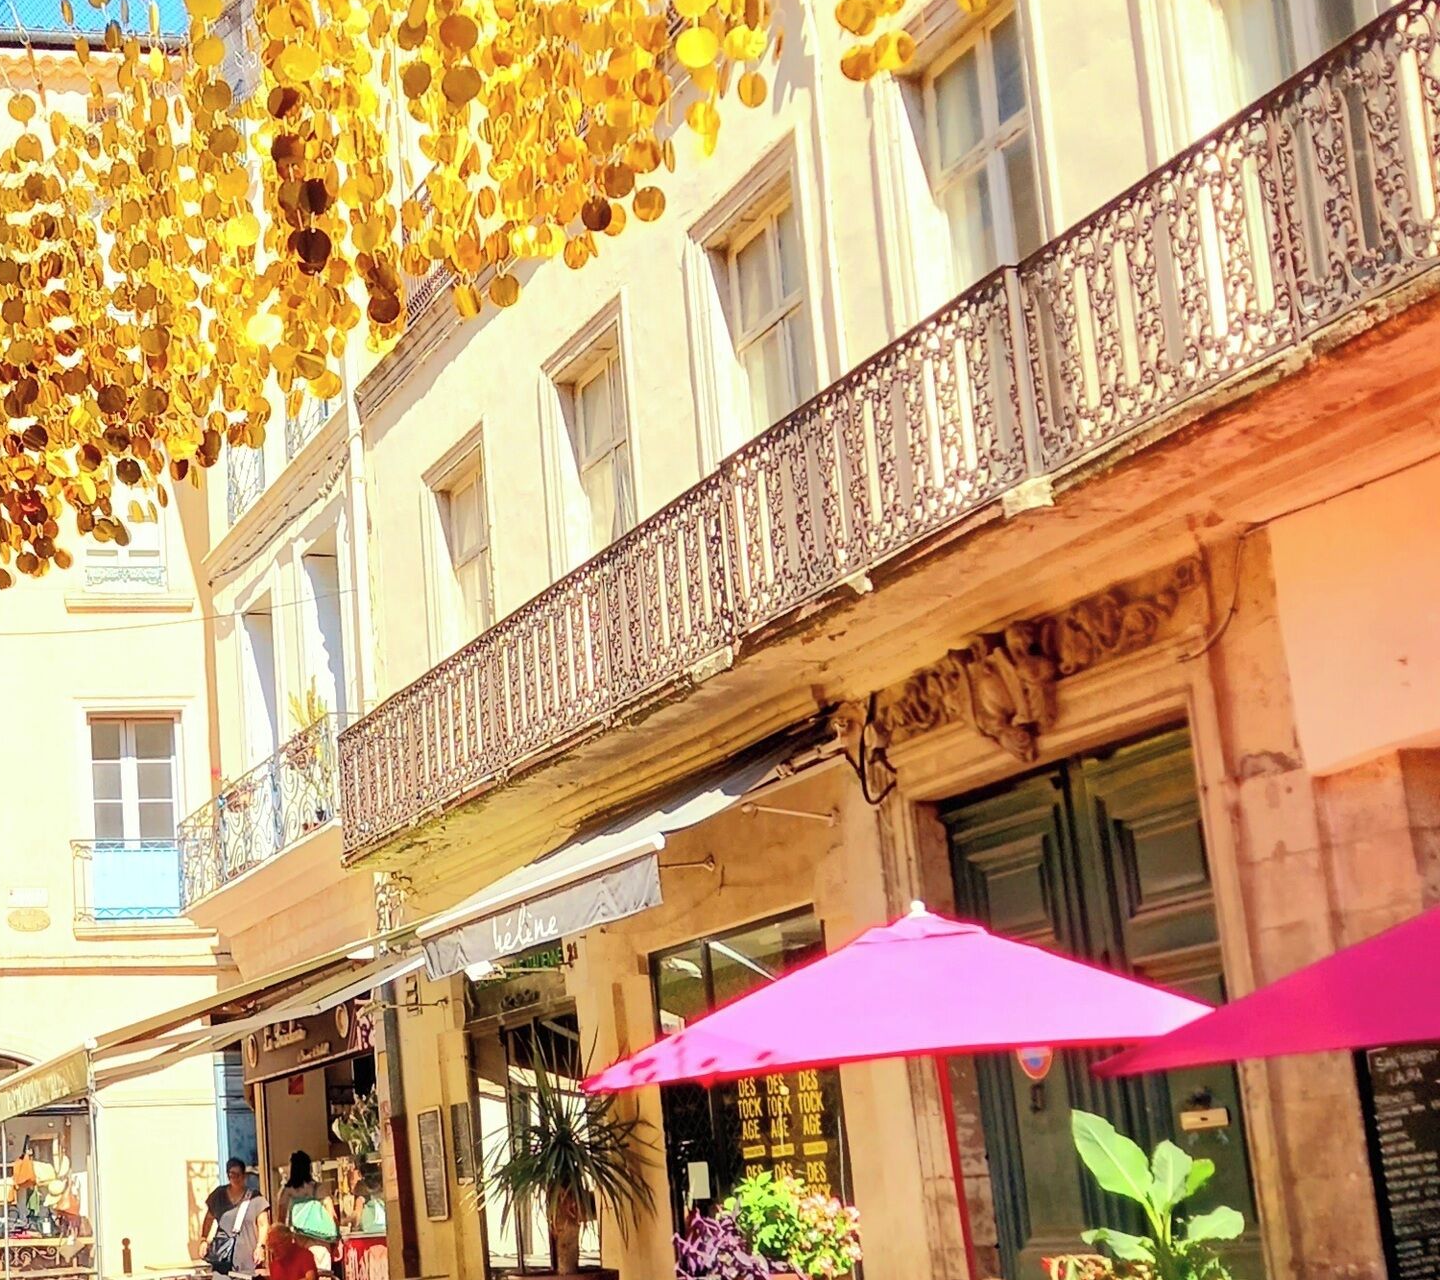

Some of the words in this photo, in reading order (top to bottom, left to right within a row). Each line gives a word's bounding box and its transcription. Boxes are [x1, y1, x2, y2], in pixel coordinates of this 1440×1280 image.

[738, 1076, 756, 1098] DES
[797, 1070, 818, 1092] DES
[737, 1096, 763, 1120] TOCK
[797, 1091, 824, 1114] TOCK
[742, 1119, 761, 1140] AGE
[803, 1113, 822, 1136] AGE
[806, 1160, 827, 1183] DES
